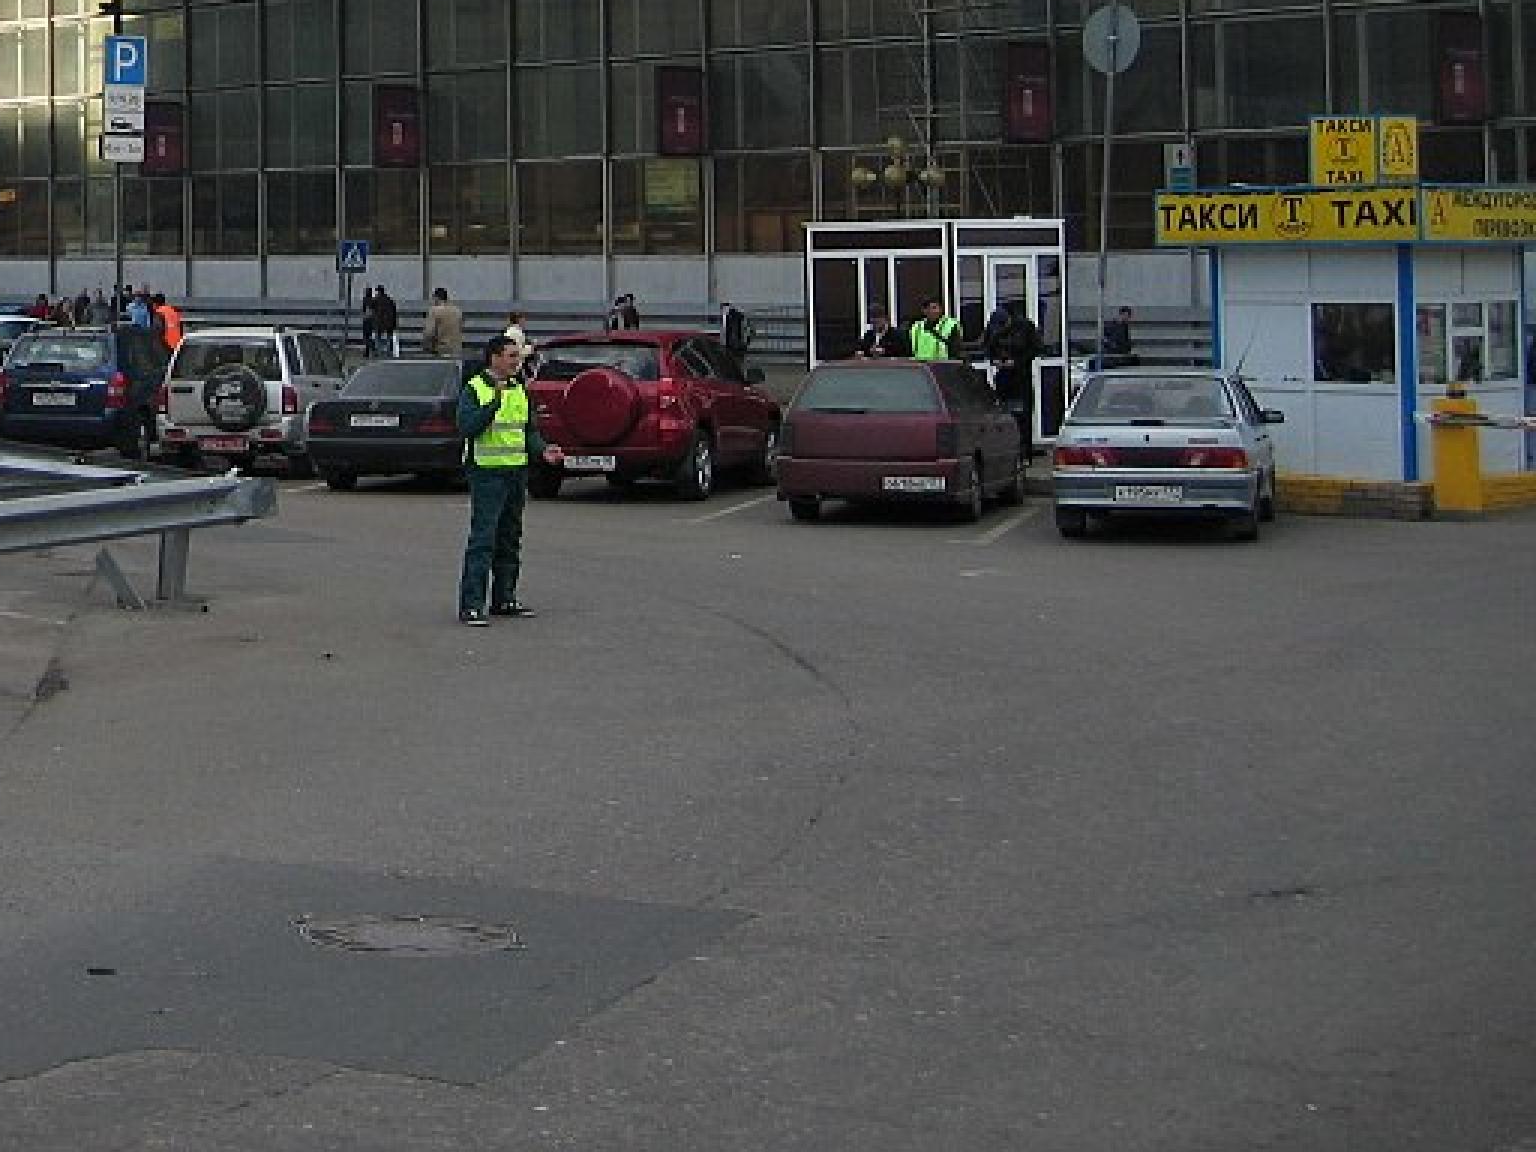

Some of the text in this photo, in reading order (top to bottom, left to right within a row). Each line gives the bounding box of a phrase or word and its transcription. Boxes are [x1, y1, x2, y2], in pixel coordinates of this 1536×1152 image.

[114, 41, 139, 82] P
[1314, 119, 1372, 134] ТАКСИ
[1326, 169, 1364, 184] TAXI
[1159, 203, 1259, 232] ТАКСИ
[1330, 197, 1416, 227] TAXI
